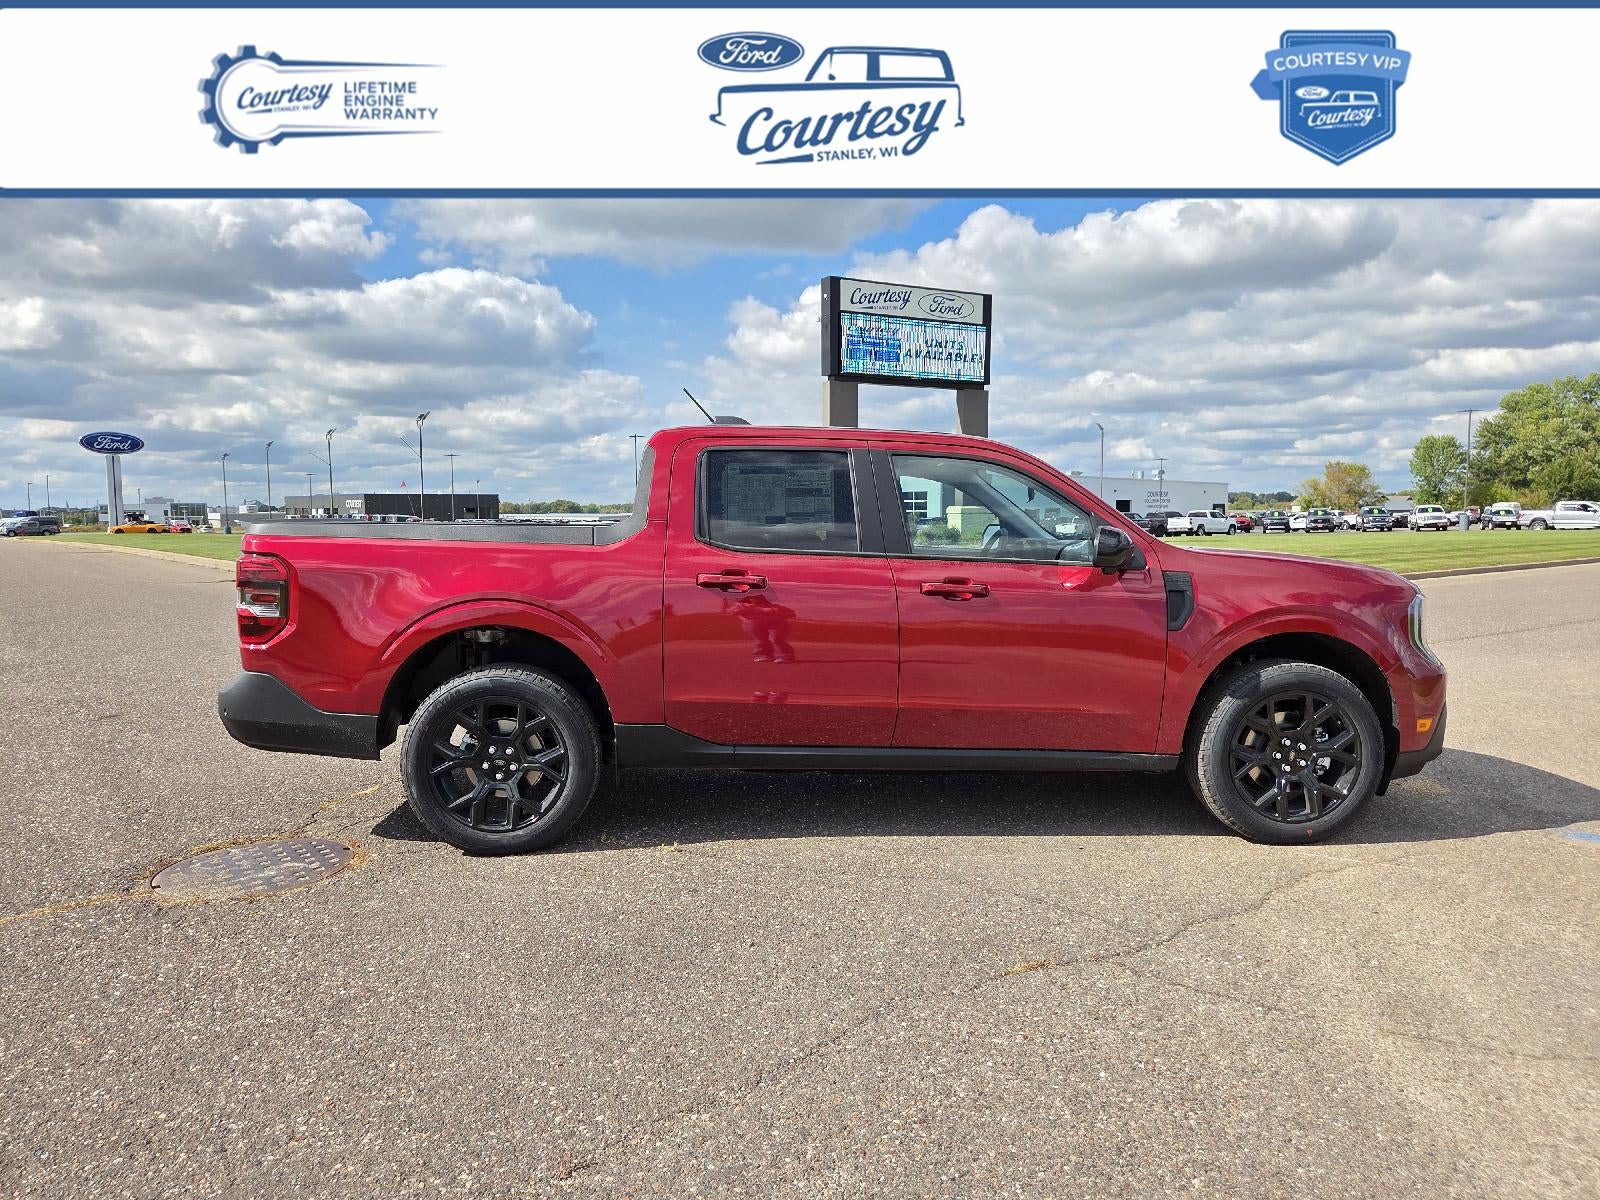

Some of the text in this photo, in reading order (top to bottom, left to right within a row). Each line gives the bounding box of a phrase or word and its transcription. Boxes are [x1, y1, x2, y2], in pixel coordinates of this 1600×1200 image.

[850, 287, 913, 310] Courtesy
[929, 295, 964, 316] Ford
[925, 338, 964, 350] UNITS
[94, 435, 131, 449] Ford
